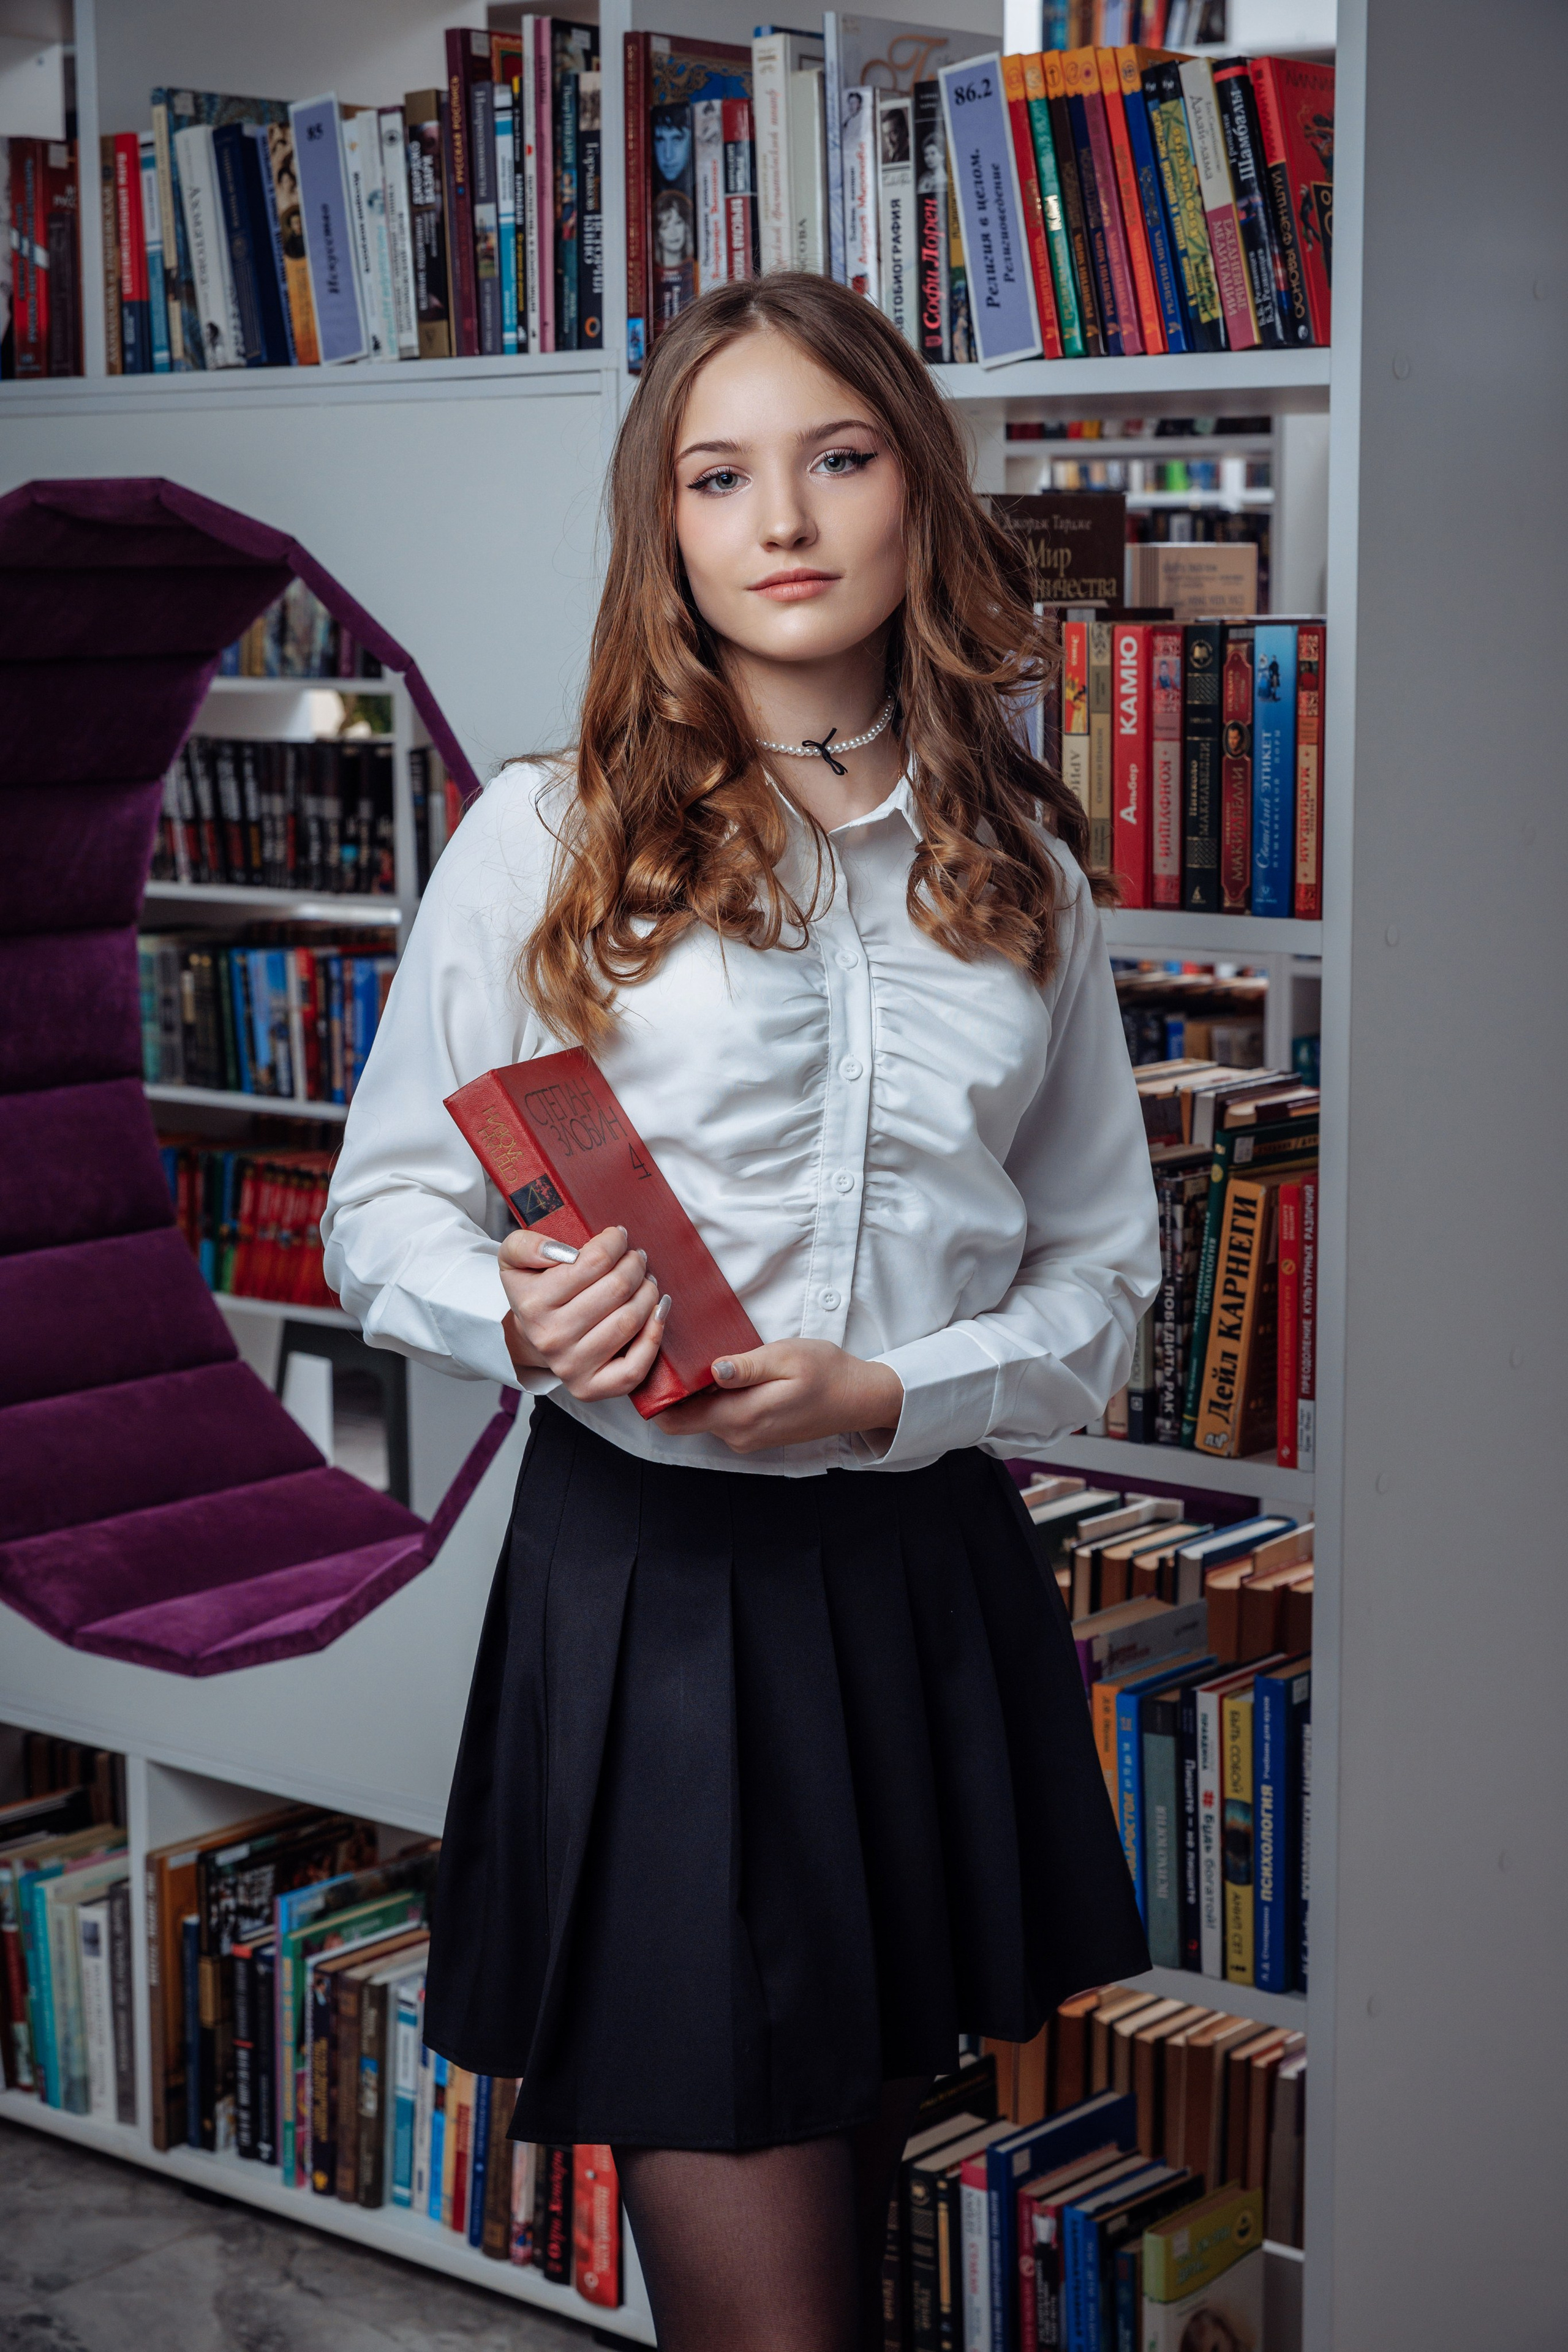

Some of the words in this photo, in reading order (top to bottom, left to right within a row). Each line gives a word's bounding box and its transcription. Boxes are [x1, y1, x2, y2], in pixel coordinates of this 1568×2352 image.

[954, 78, 993, 105] 86.2
[1230, 88, 1255, 181] Шамбалы
[968, 148, 988, 212] целом.
[921, 198, 945, 267] Лорен
[979, 217, 989, 227] в
[990, 163, 1015, 284] Религиоведение
[921, 267, 945, 330] Софи
[979, 232, 1000, 308] Религия
[1212, 221, 1238, 317] МЕДИТАЦИИ
[1285, 247, 1306, 319] ОСНОВЫ
[1028, 537, 1072, 578] Мир
[1120, 636, 1138, 735] КАМЮ
[1261, 729, 1272, 793] ЭТИКЕТ
[1159, 760, 1173, 858] КОНФУЦИЙ
[1230, 766, 1245, 882] МАКИАВЕЛЛИ
[524, 1077, 602, 1126] СТЕПАН
[551, 1106, 628, 1156] ЗЛОБИН
[628, 1142, 652, 1180] 4
[1304, 1184, 1315, 1240] РАЗЛИЧИЙ
[1217, 1194, 1259, 1342] КАРНЕГИ
[1303, 1245, 1314, 1314] КУЛЬТУРНЫХ
[1164, 1285, 1175, 1377] ПОБЕДИТЬ
[1302, 1319, 1313, 1395] ПРЕОДОЛЕНИЕ
[1164, 1381, 1175, 1412] РАК
[1207, 1350, 1238, 1425] Дейл
[1261, 1784, 1273, 1901] ПСИХОЛОГИЯ
